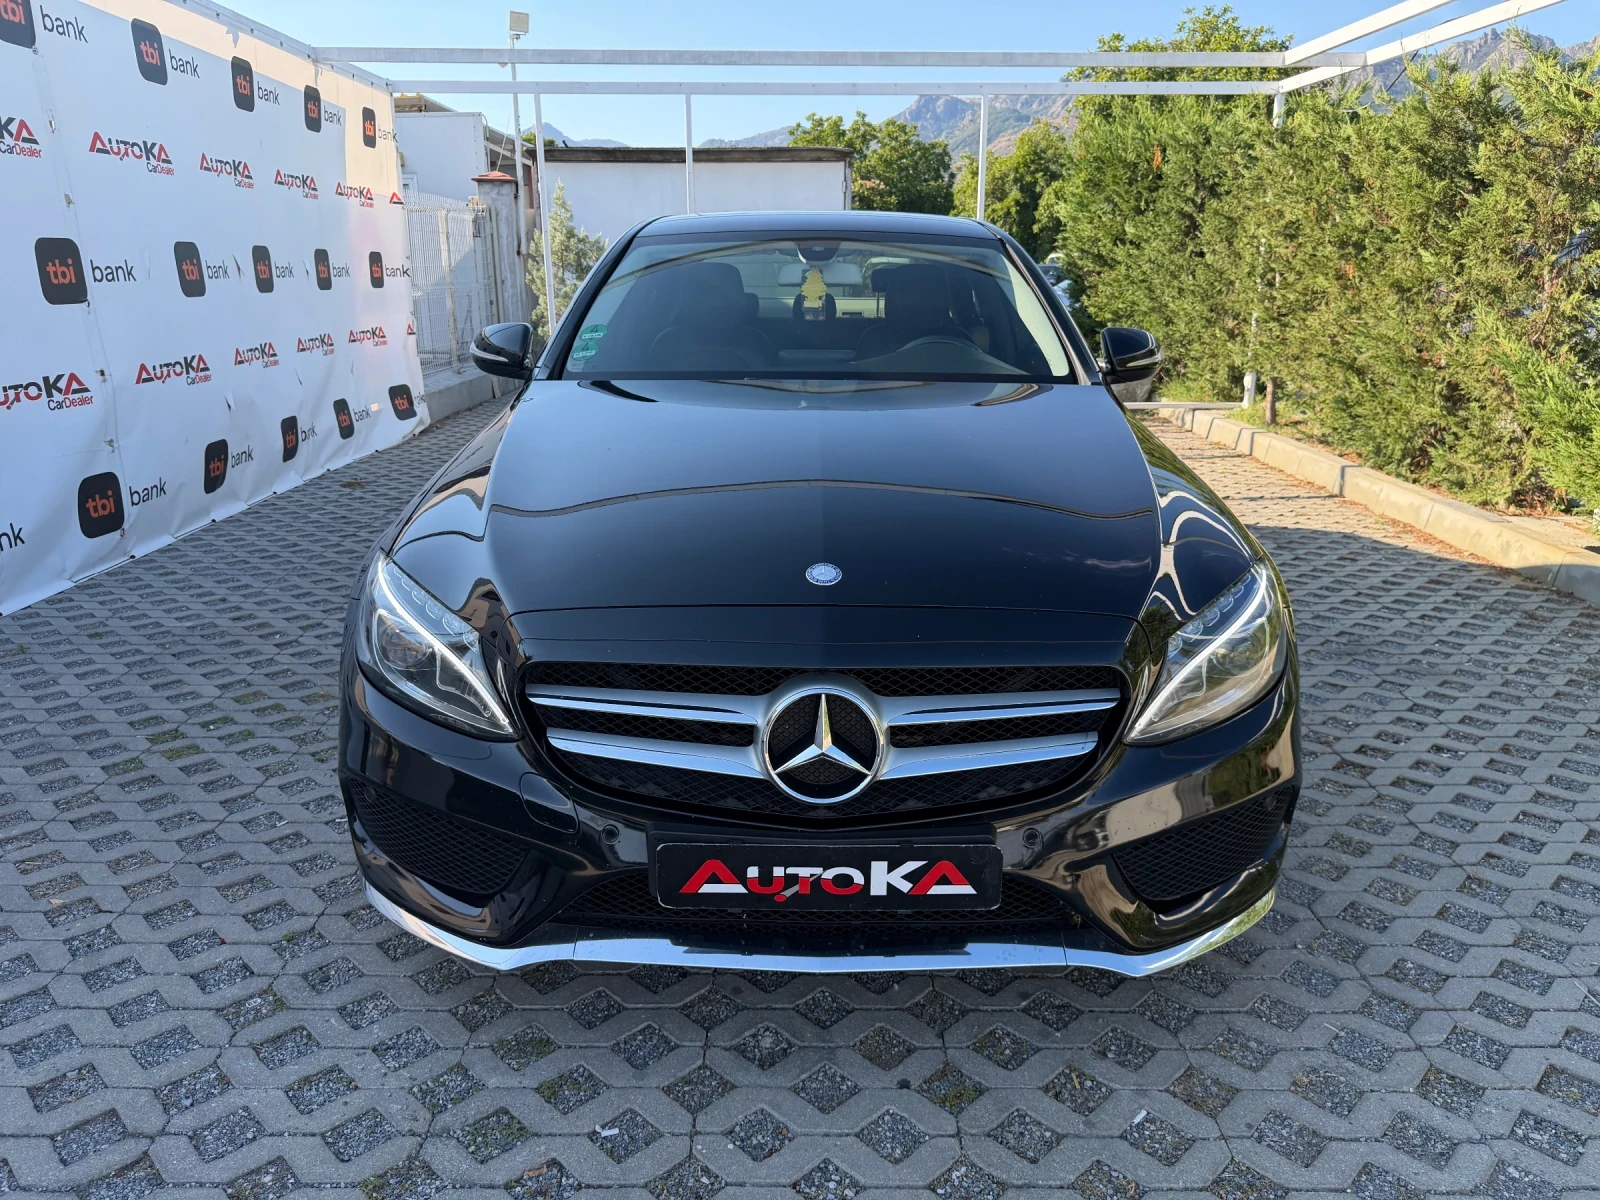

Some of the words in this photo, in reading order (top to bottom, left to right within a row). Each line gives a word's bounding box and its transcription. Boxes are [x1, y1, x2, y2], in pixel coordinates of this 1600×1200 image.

[0, 0, 26, 25] tbi
[40, 7, 88, 44] bank
[140, 40, 160, 66] tbi
[169, 49, 200, 79] bank
[236, 75, 250, 96] tbi
[257, 81, 279, 105] bank
[308, 100, 318, 120] tbi
[323, 105, 342, 127] bank
[365, 120, 374, 137] tbi
[377, 126, 398, 143] bank
[147, 162, 174, 176] CarDealer
[234, 177, 254, 189] CarDealer
[46, 258, 75, 284] tbi
[90, 259, 136, 283] bank
[182, 259, 199, 280] tbi
[206, 260, 230, 280] bank
[257, 261, 270, 278] tbi
[274, 262, 294, 279] bank
[318, 262, 328, 277] tbi
[331, 262, 350, 278] bank
[372, 262, 381, 277] tbi
[385, 265, 410, 278] bank
[590, 325, 598, 333] 4
[582, 343, 589, 351] 4
[262, 359, 279, 368] CarDealer
[186, 372, 212, 386] CarDealer
[47, 395, 93, 411] CarDealer
[394, 395, 409, 410] tbi
[338, 410, 350, 428] tbi
[354, 405, 371, 423] bank
[286, 428, 296, 448] tbi
[301, 422, 317, 442] bank
[209, 455, 224, 478] tbi
[231, 445, 254, 469] bank
[86, 490, 115, 518] tbi
[129, 477, 167, 506] bank
[680, 859, 977, 902] AUTOKA
